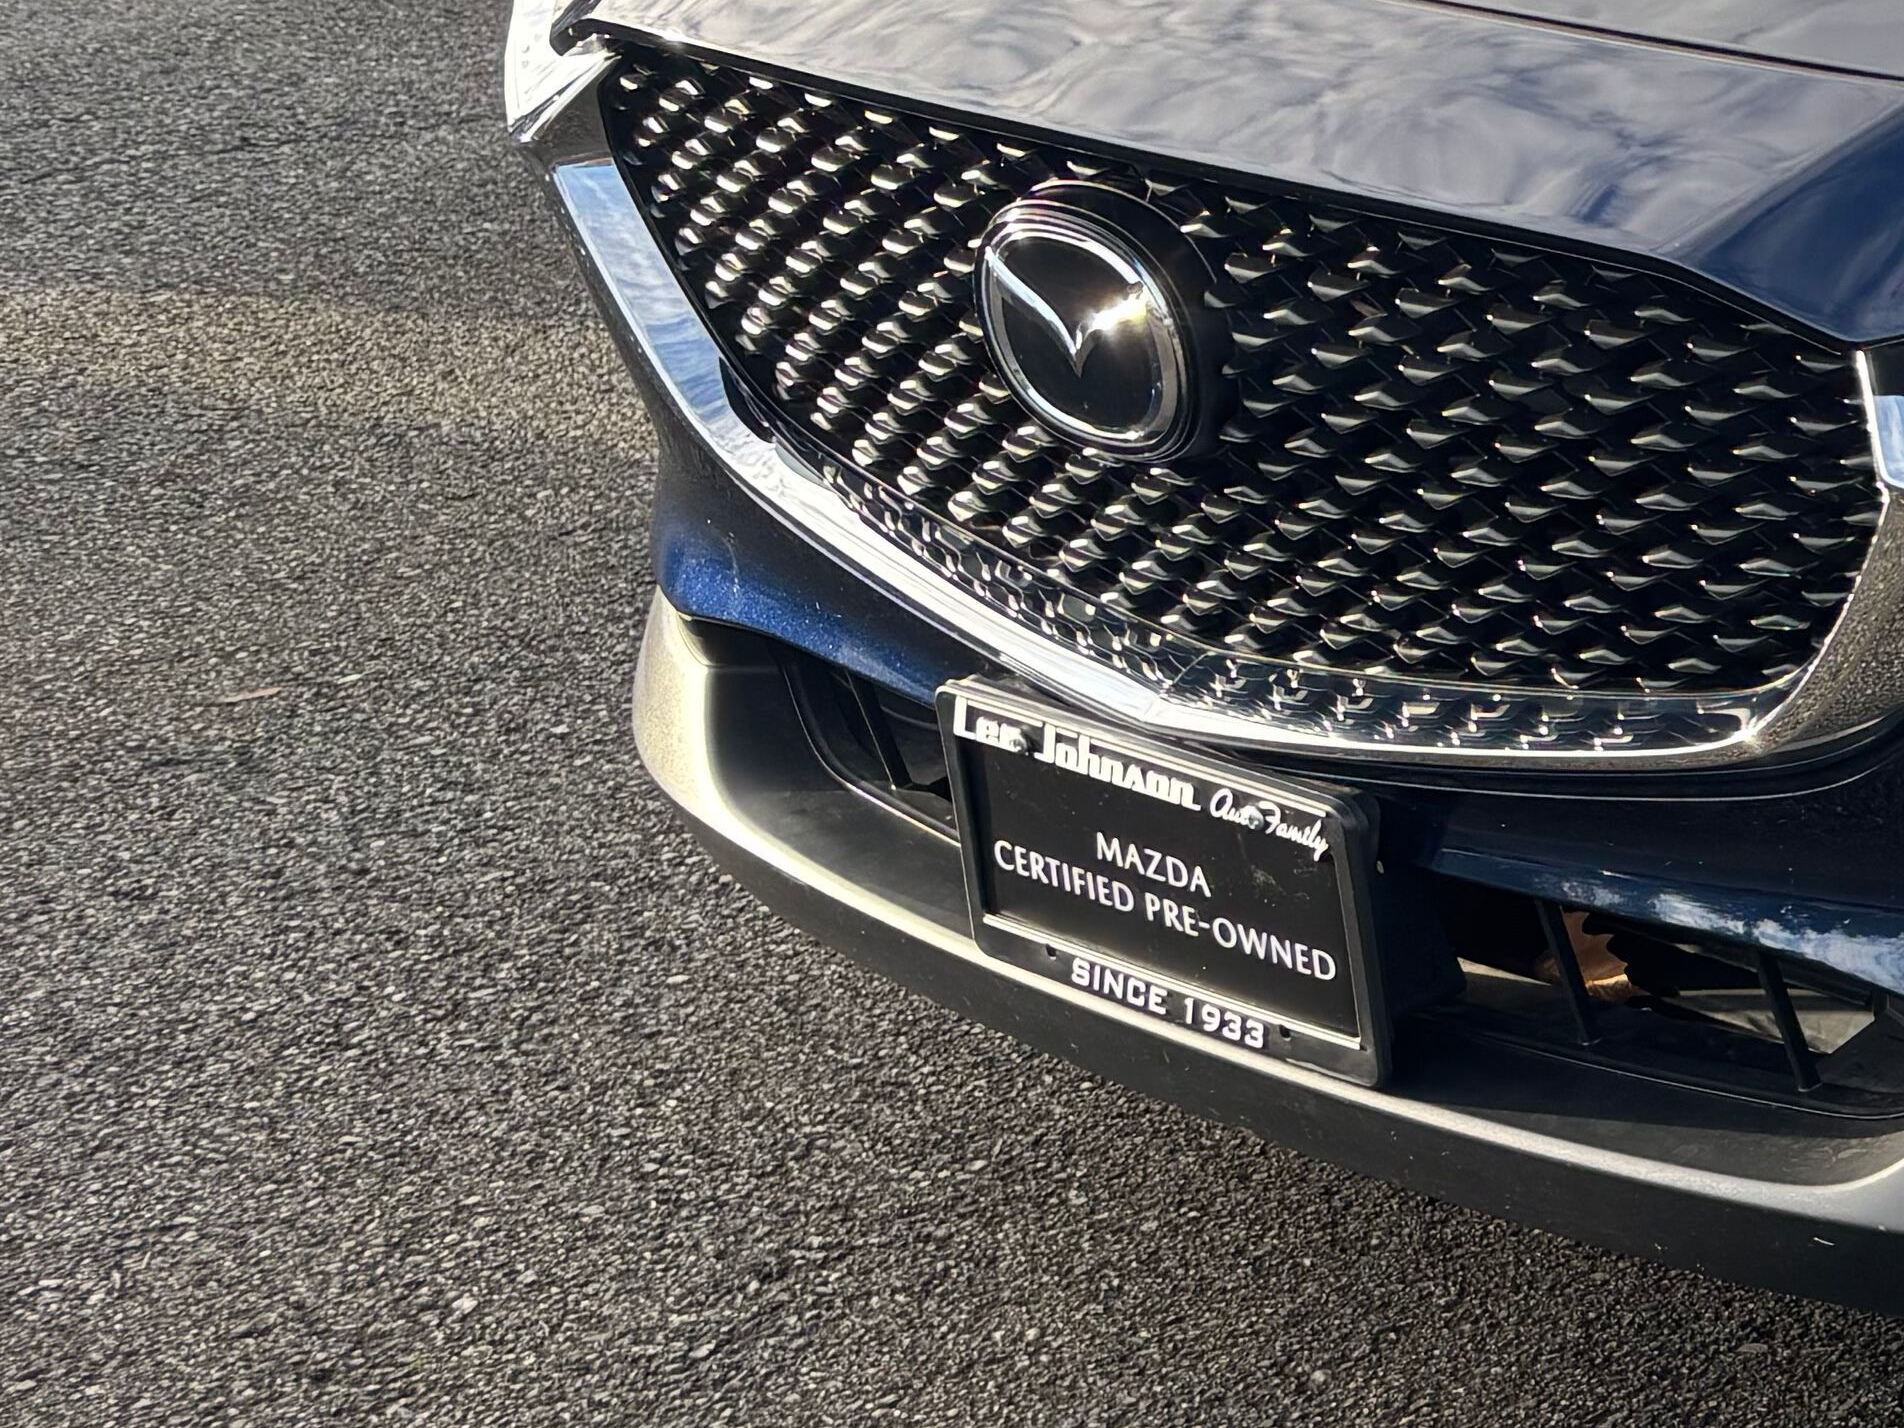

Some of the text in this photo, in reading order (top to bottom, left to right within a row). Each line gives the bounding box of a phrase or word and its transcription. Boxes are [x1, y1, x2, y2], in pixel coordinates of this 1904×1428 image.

[1034, 722, 1201, 812] Johnson
[1259, 800, 1329, 862] Family
[993, 839, 1337, 981] CERTIFIED PRE-OWNED
[1095, 831, 1213, 898] MAZDA
[1070, 957, 1265, 1050] SINCE 1933
